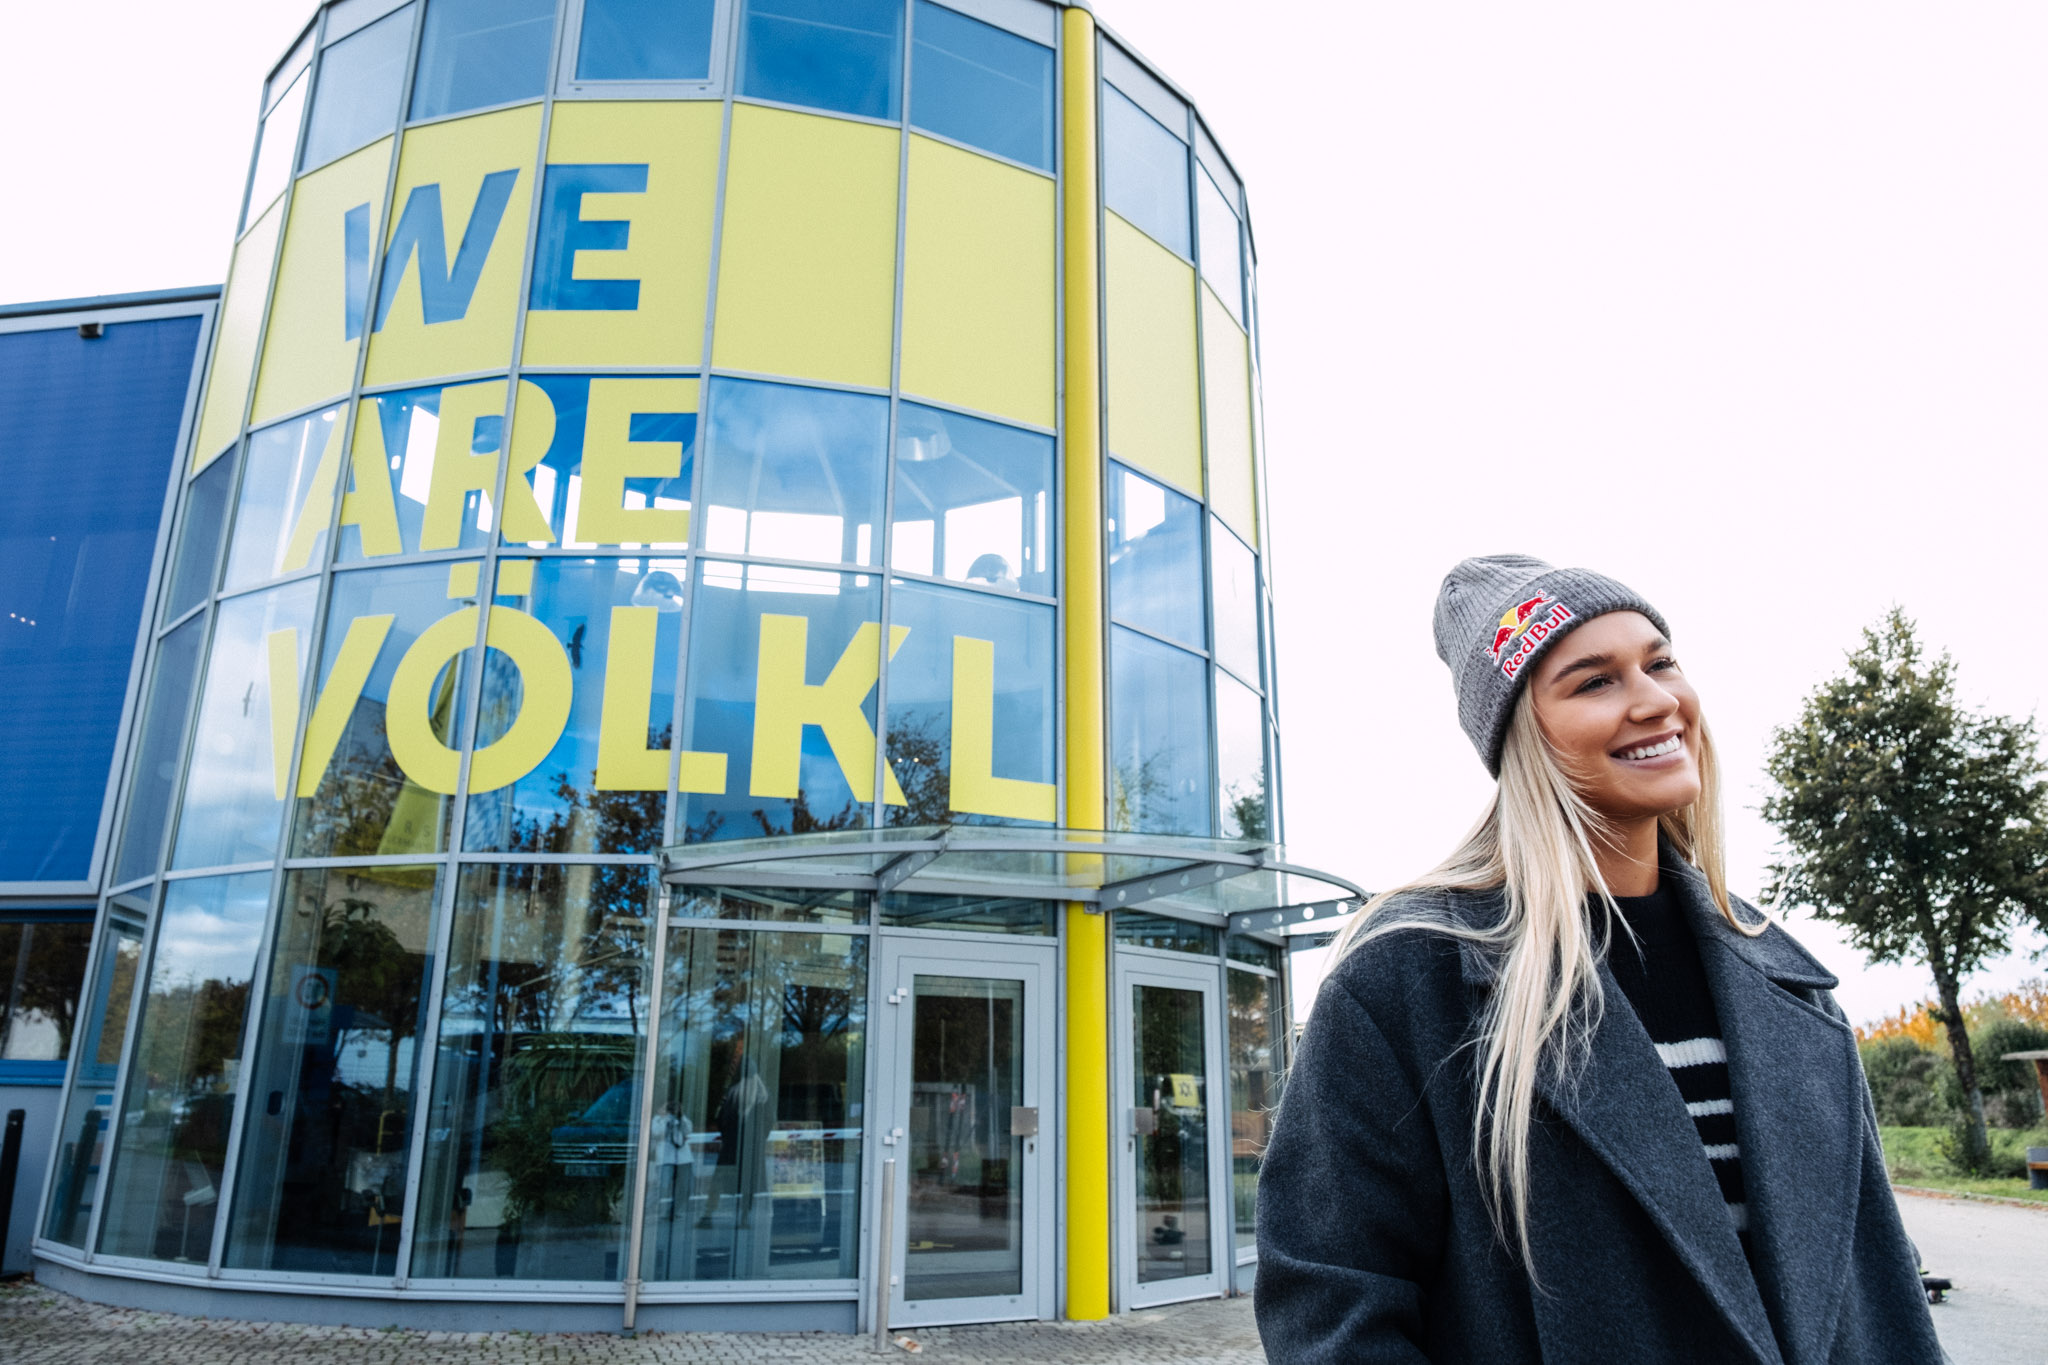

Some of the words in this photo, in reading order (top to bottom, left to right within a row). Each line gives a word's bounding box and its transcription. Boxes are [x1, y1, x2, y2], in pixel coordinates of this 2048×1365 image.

[345, 163, 649, 342] WE
[281, 378, 701, 573] ARE
[267, 560, 1055, 823] VÖLKL
[1502, 635, 1536, 679] Red
[1529, 603, 1573, 642] Bull
